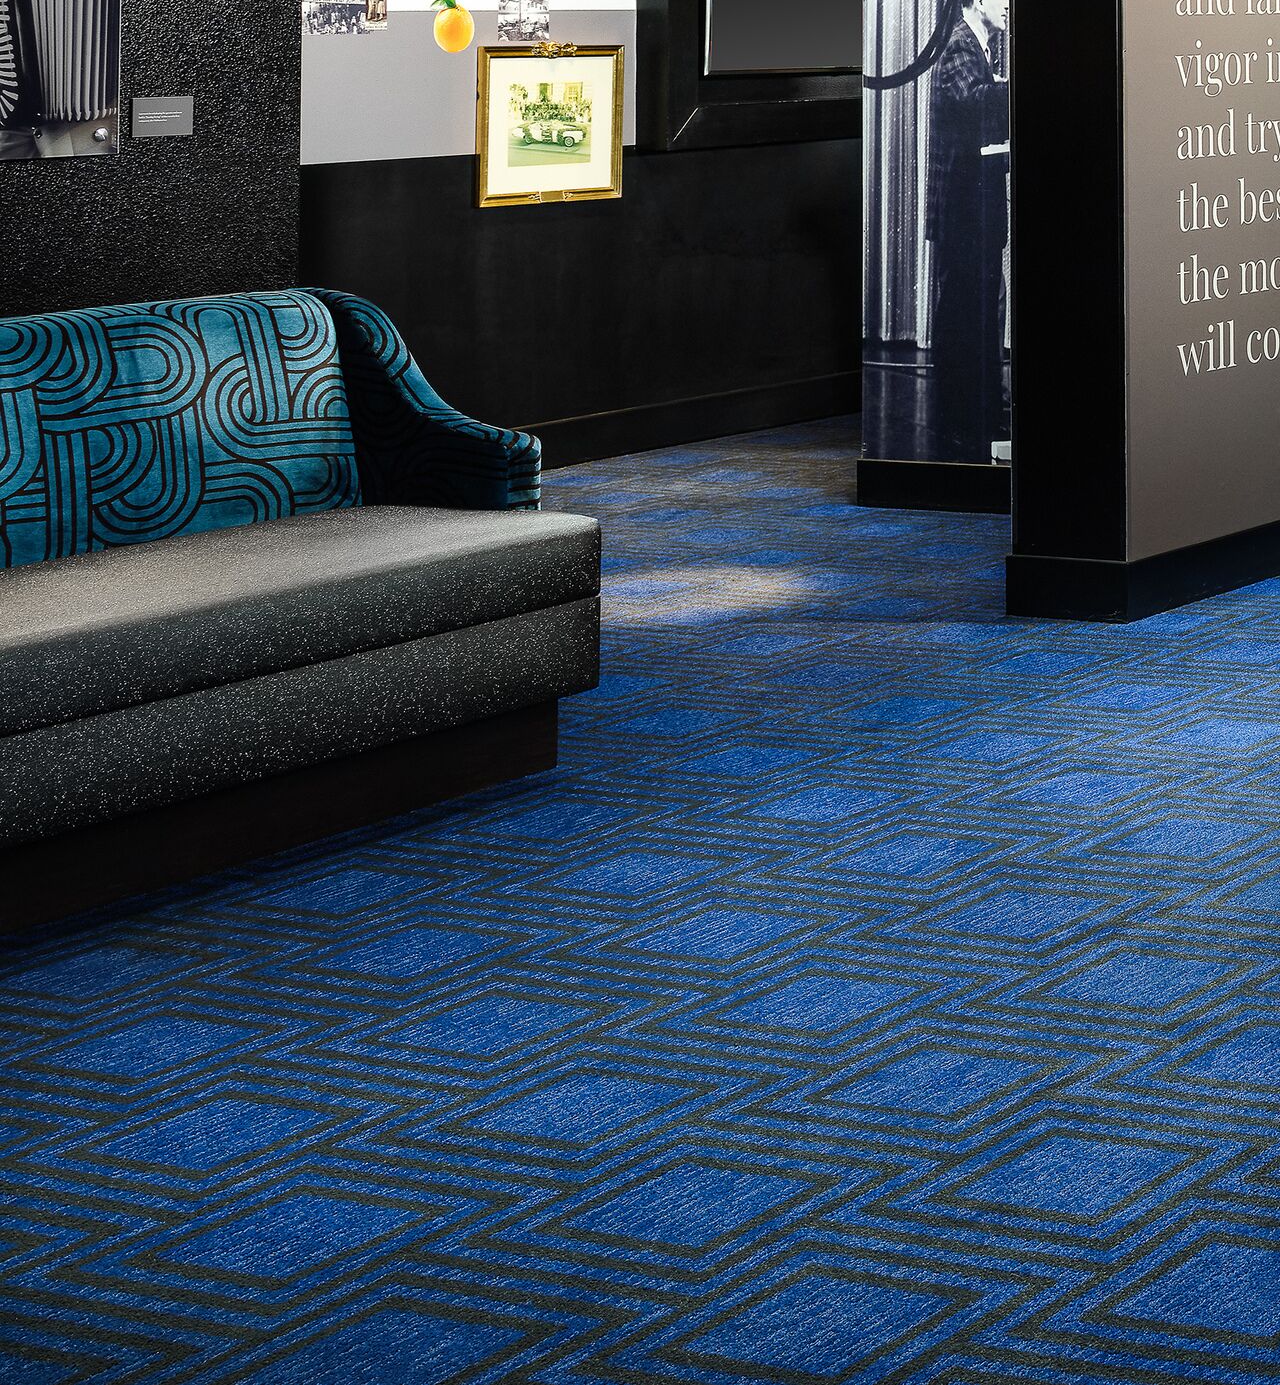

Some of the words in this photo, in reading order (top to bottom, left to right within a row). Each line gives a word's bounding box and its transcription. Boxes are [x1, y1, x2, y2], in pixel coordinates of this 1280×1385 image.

[1174, 39, 1258, 97] vigor
[1177, 108, 1237, 160] and
[1176, 182, 1229, 232] the
[1176, 253, 1230, 305] the
[1176, 319, 1237, 377] will
